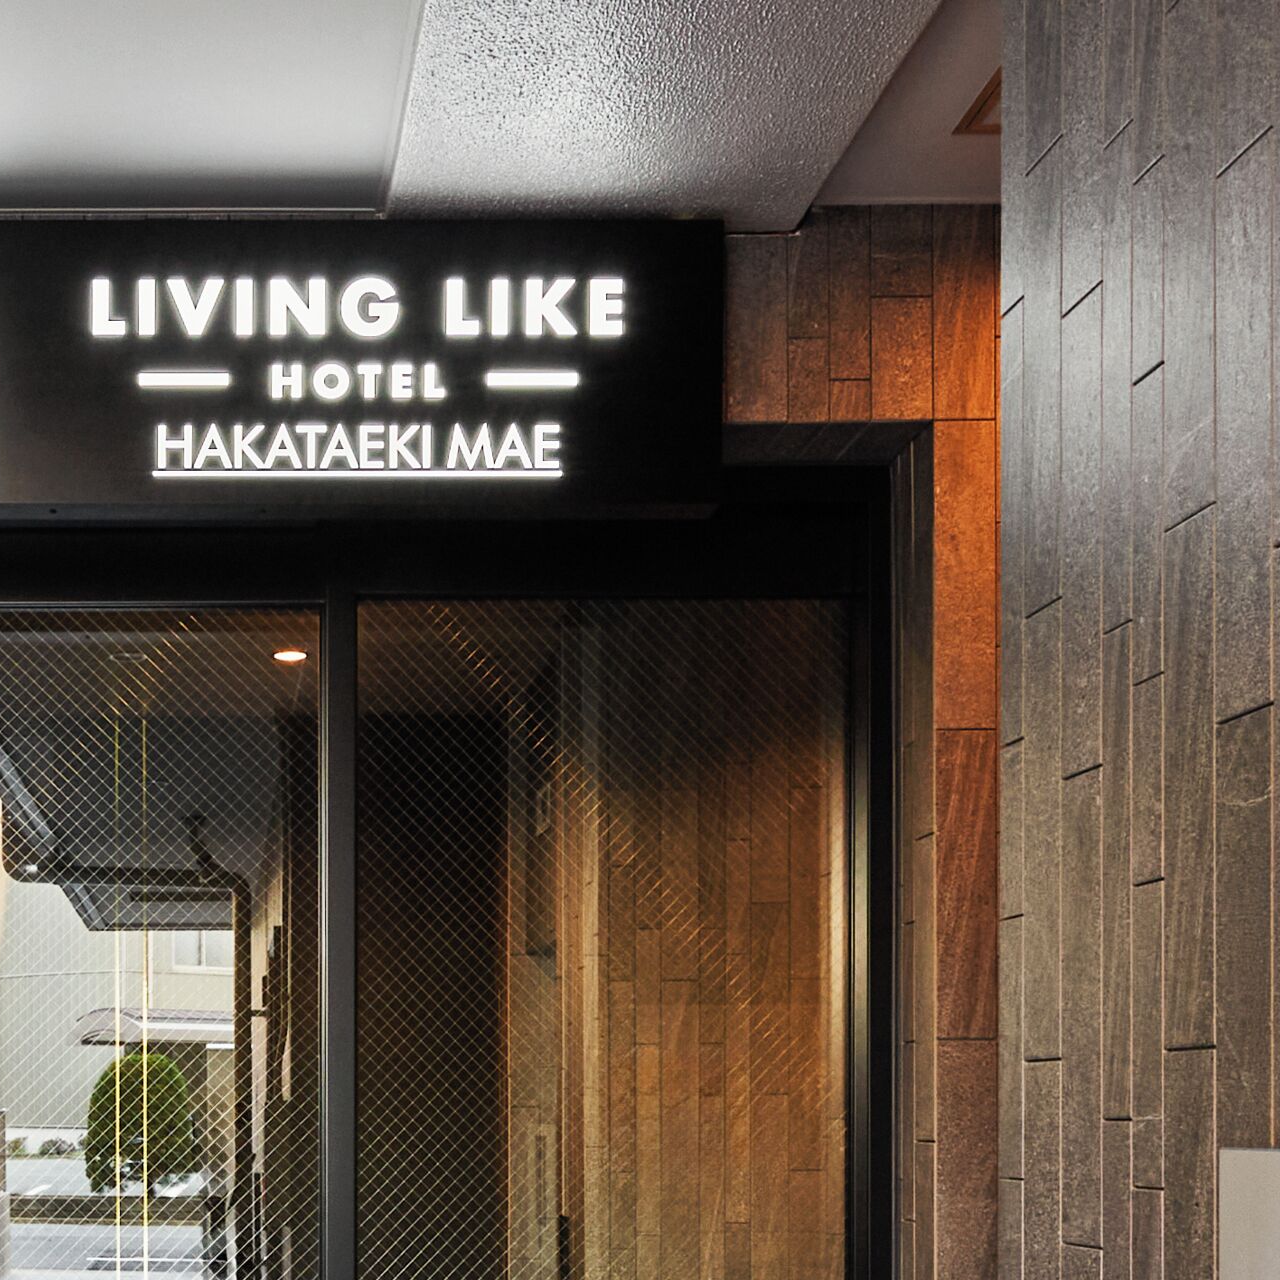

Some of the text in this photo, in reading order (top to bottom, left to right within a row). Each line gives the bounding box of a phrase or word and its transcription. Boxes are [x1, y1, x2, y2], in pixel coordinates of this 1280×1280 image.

[91, 276, 623, 338] LIVING LIKE
[269, 362, 446, 400] HOTEL
[157, 423, 560, 469] HAKATAEKI MAE
